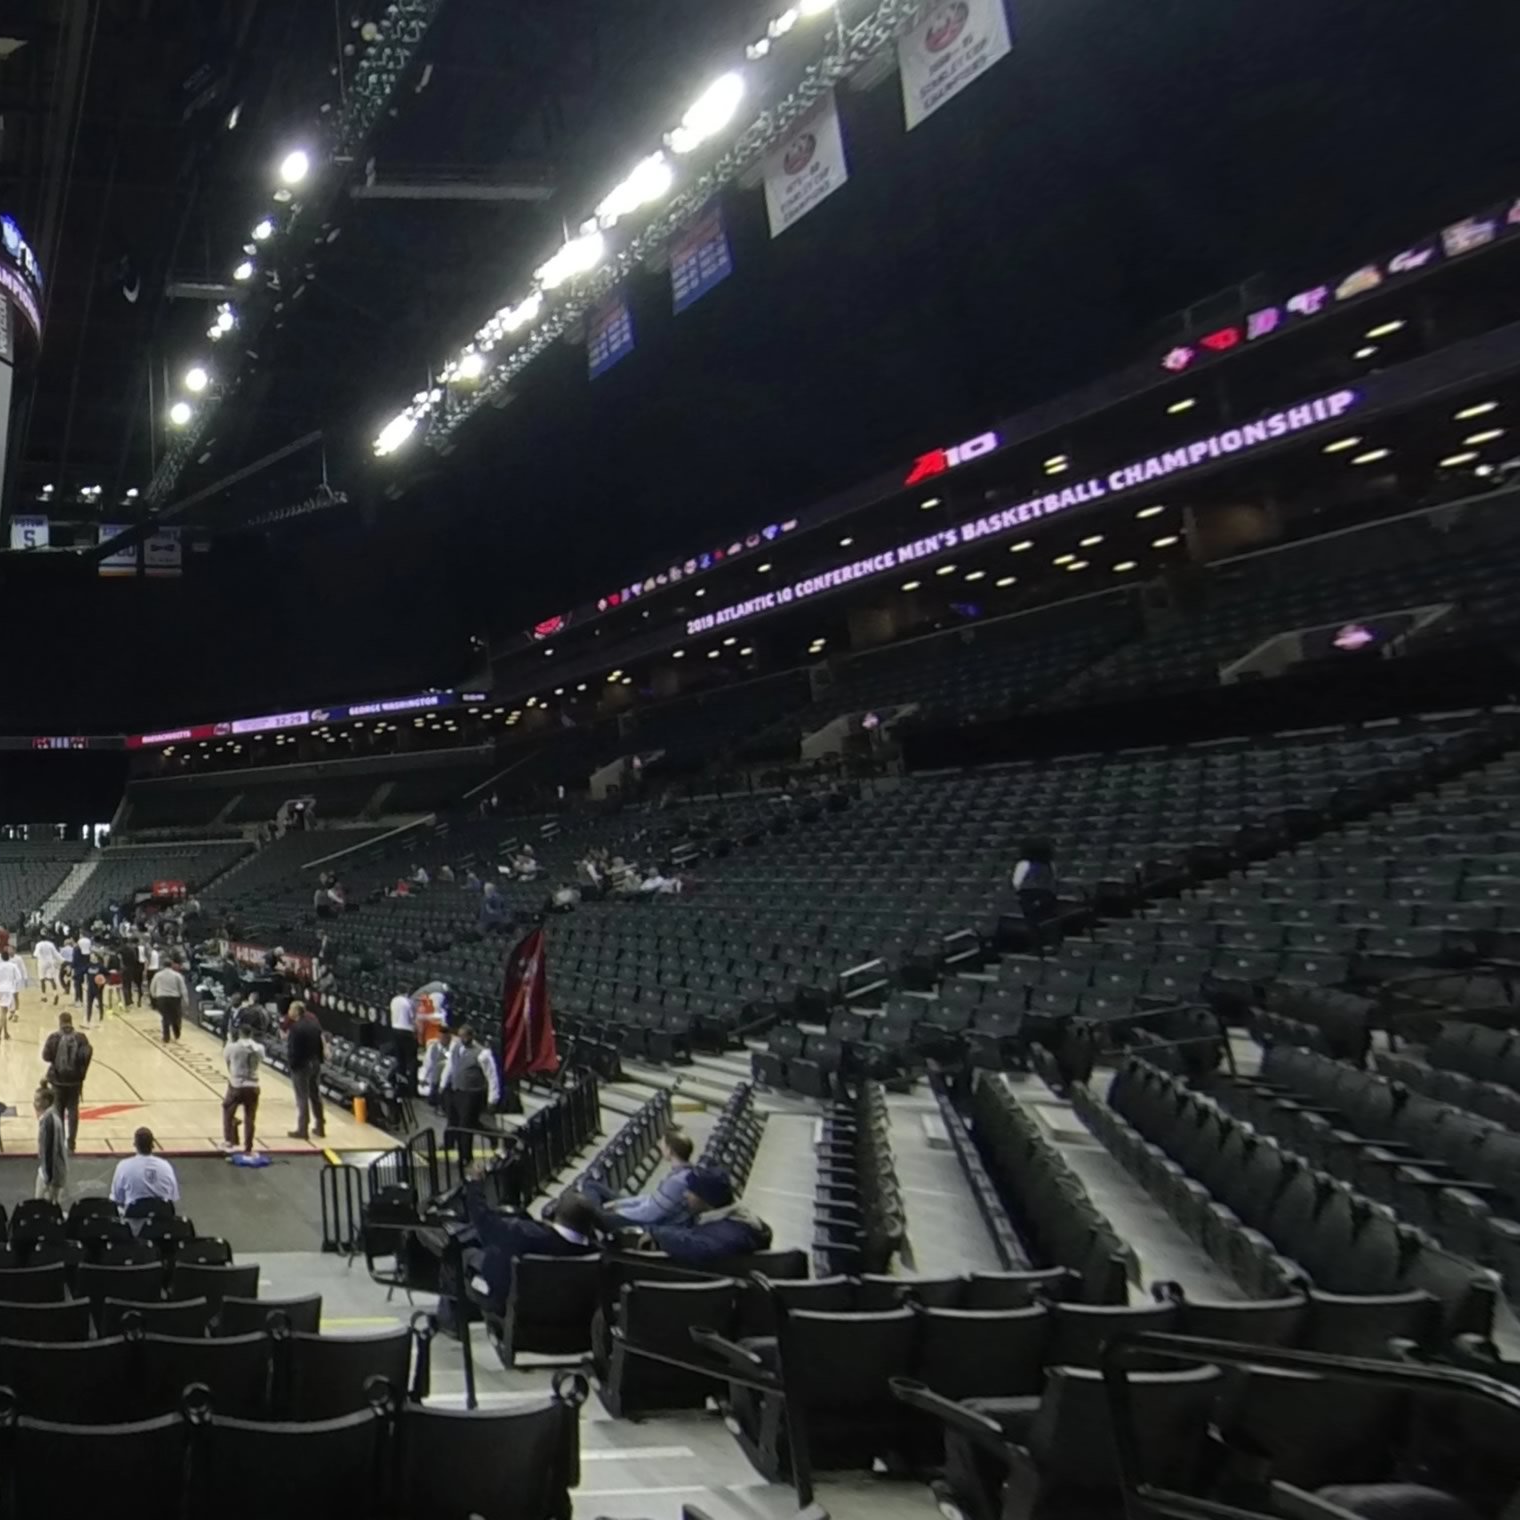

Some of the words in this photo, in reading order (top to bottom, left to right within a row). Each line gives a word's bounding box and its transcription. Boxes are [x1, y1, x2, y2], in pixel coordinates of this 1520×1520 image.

[903, 431, 998, 487] A10
[686, 614, 715, 635] 2019
[716, 593, 774, 625] ATLANTIC
[777, 586, 793, 604] 10
[794, 550, 895, 598] CONFERENCE
[897, 528, 958, 563] MEN'S
[961, 479, 1105, 542] BASKETBALL
[1108, 389, 1354, 491] CHAMPIONSHIP
[348, 702, 380, 716] GEORGE
[381, 696, 438, 711] WASHINGTON
